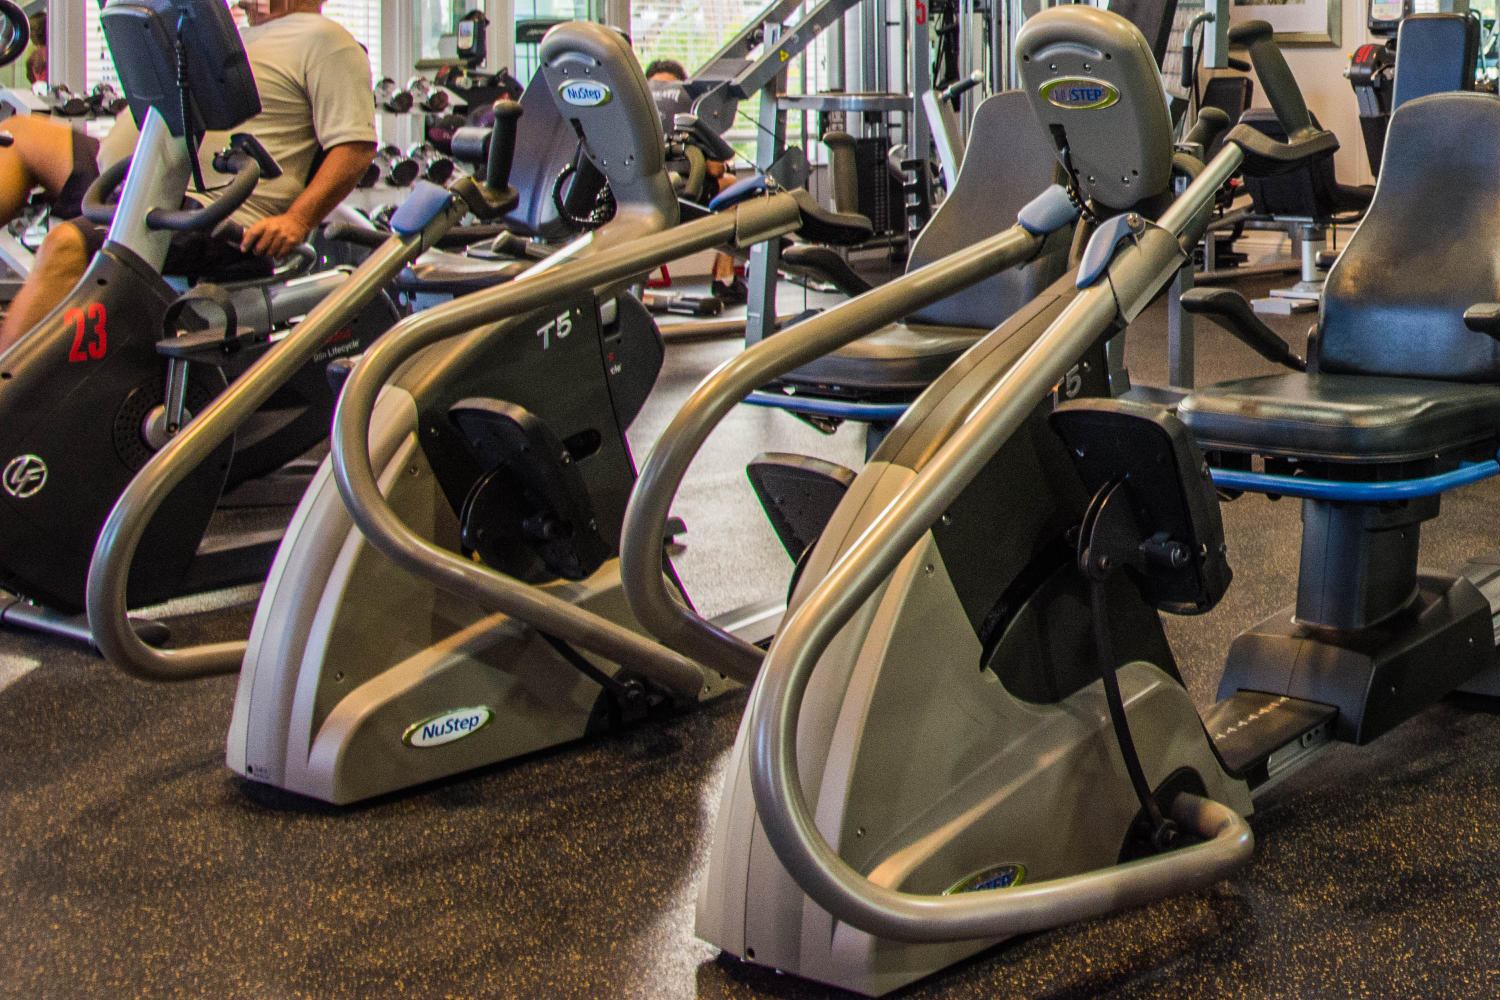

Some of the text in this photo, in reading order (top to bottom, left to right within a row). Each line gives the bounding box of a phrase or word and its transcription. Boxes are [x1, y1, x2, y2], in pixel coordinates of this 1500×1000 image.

[567, 87, 602, 101] NuStep
[63, 302, 108, 363] 23
[536, 309, 573, 350] T5
[422, 715, 480, 741] NuStep
